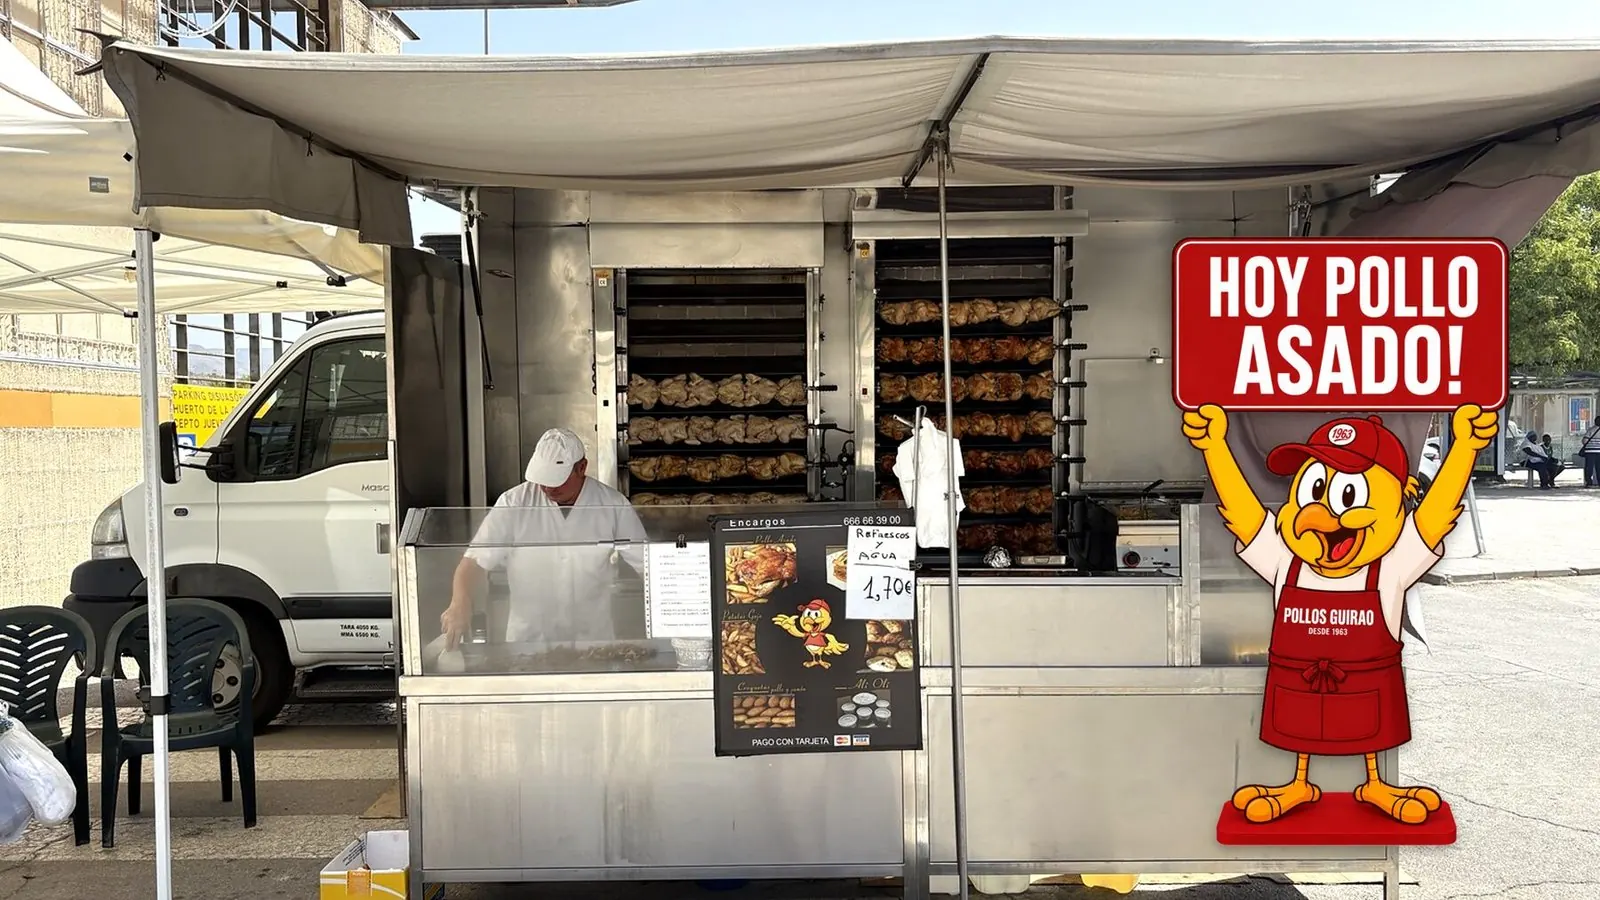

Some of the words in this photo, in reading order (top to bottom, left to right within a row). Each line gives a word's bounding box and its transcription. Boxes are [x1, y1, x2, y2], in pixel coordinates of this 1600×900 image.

[1209, 255, 1309, 318] HOY
[1325, 255, 1479, 318] POLLO
[1233, 324, 1463, 396] ASADO!
[173, 389, 206, 400] PARKING
[173, 403, 205, 415] HUERTO
[208, 404, 217, 415] DE
[220, 405, 229, 415] LA
[1332, 428, 1353, 439] 1963
[729, 518, 786, 529] Encargos
[843, 516, 860, 526] 666
[862, 516, 874, 525] 66
[876, 515, 888, 525] 39
[889, 515, 901, 524] 00
[858, 551, 897, 560] AGUA
[863, 575, 912, 601] 1,70€
[1283, 607, 1327, 625] POLLOS
[1329, 608, 1375, 626] GUIRAO
[1308, 627, 1329, 635] DESDE
[1332, 628, 1348, 636] 1963
[752, 738, 774, 746] PAGO
[776, 737, 794, 746] CON
[796, 737, 829, 745] TARJETA
